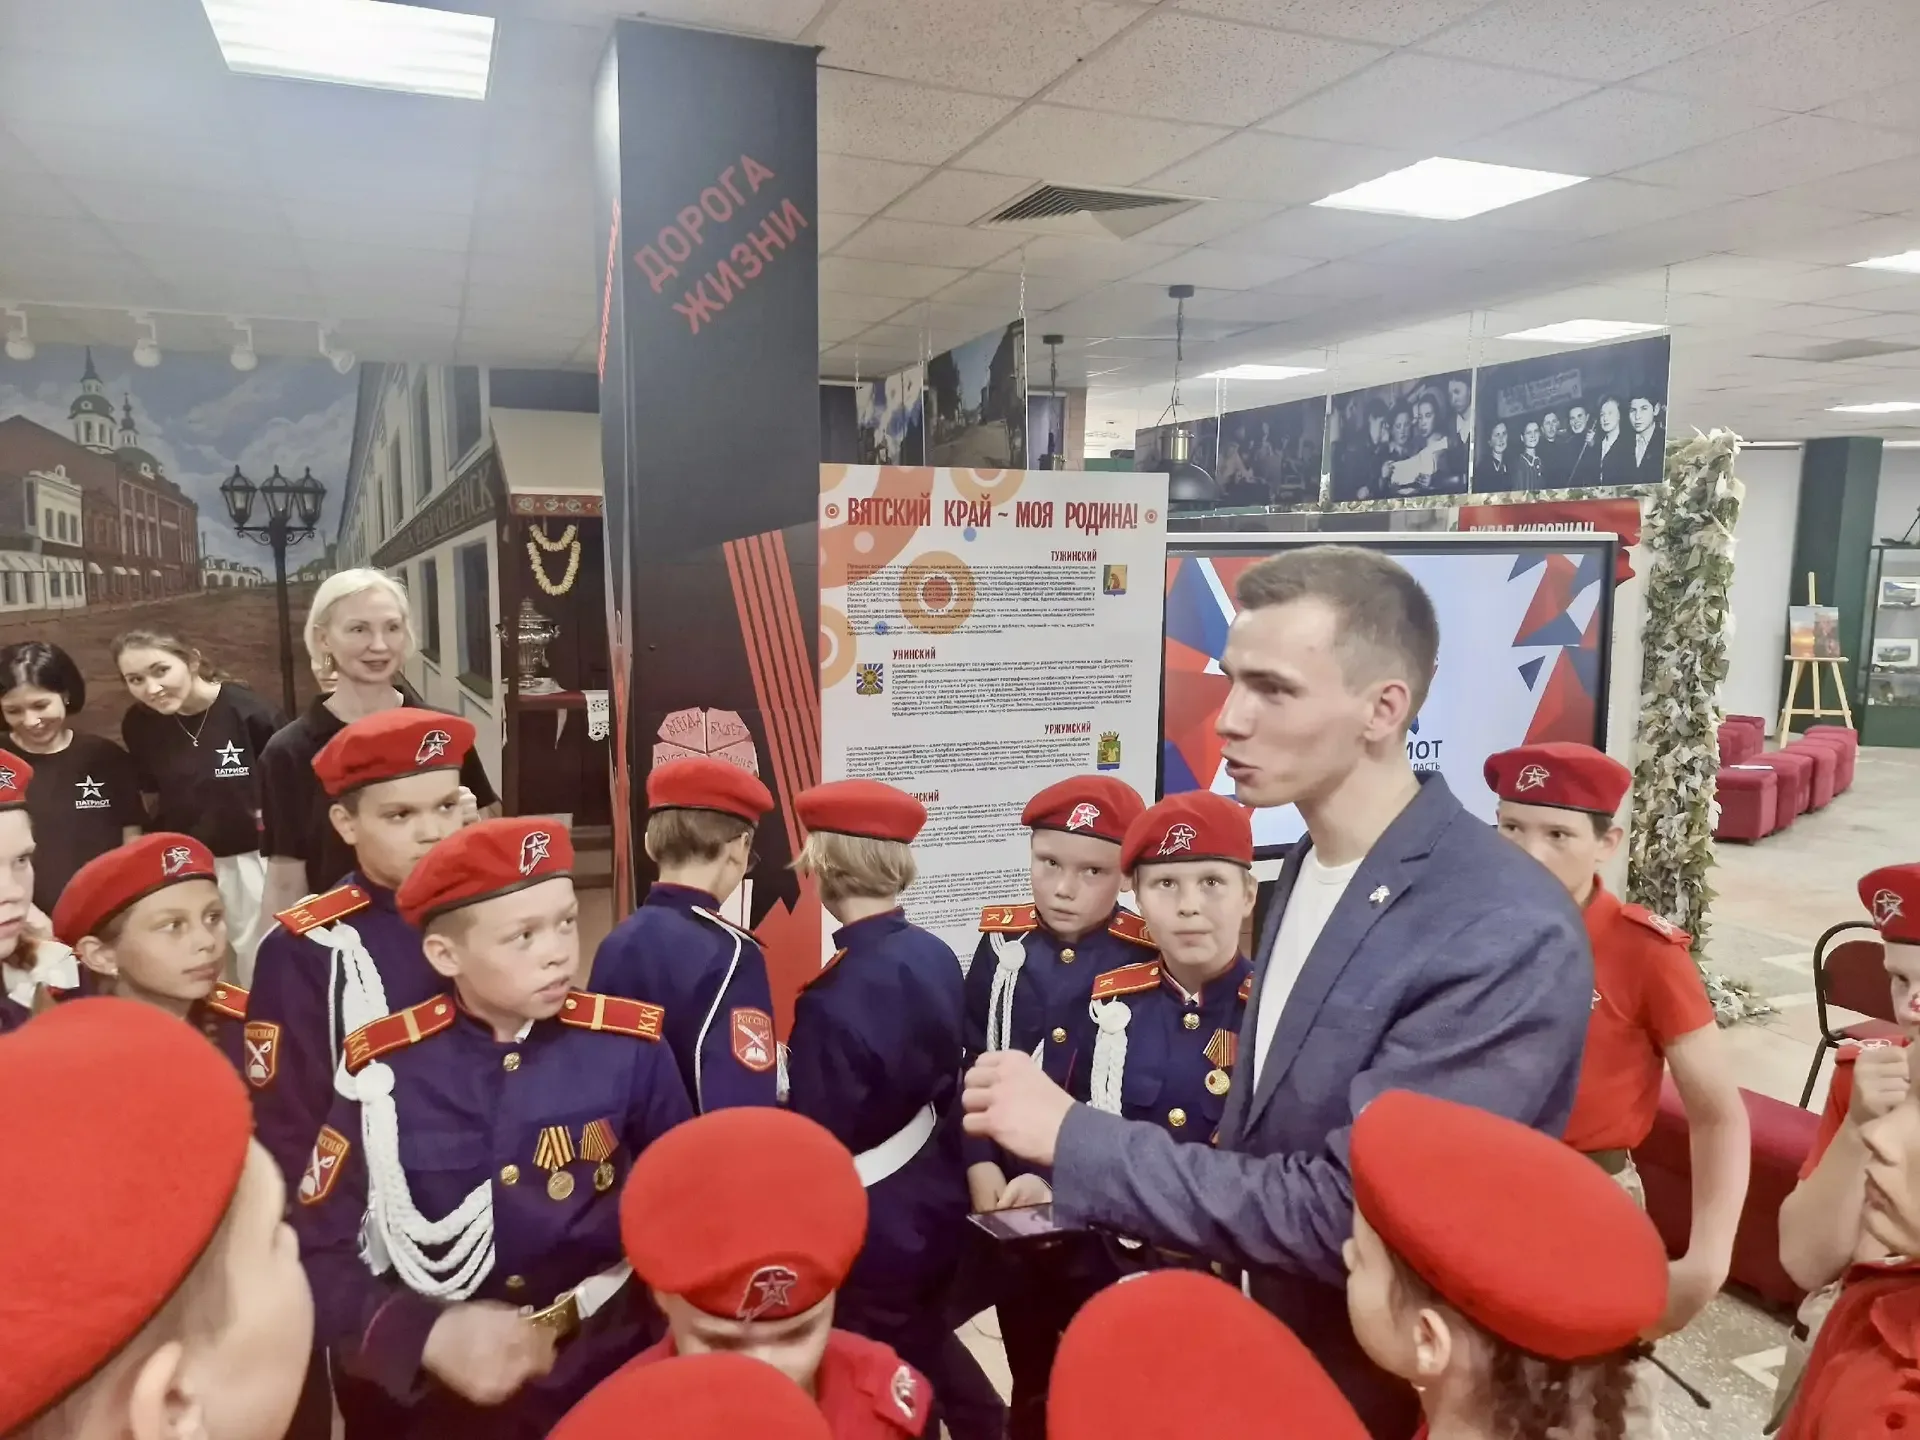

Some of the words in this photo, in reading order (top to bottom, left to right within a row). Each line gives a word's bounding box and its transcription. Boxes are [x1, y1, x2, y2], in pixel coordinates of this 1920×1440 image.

[633, 154, 775, 294] ДОРОГА
[672, 198, 808, 334] ЖИЗНИ
[848, 492, 931, 527] ВЯТСКИЙ
[944, 493, 991, 528] КРАЙ
[1016, 501, 1053, 528] МОЯ
[1065, 501, 1138, 536] РОДИНА!
[1051, 549, 1097, 562] ТУЖИНСКИЙ
[893, 646, 936, 660] УНИНСКИЙ
[1044, 721, 1091, 734] УРЖУМСКИЙ
[215, 766, 250, 775] ПАТРИОТ
[76, 798, 111, 806] ПАТРИОТ
